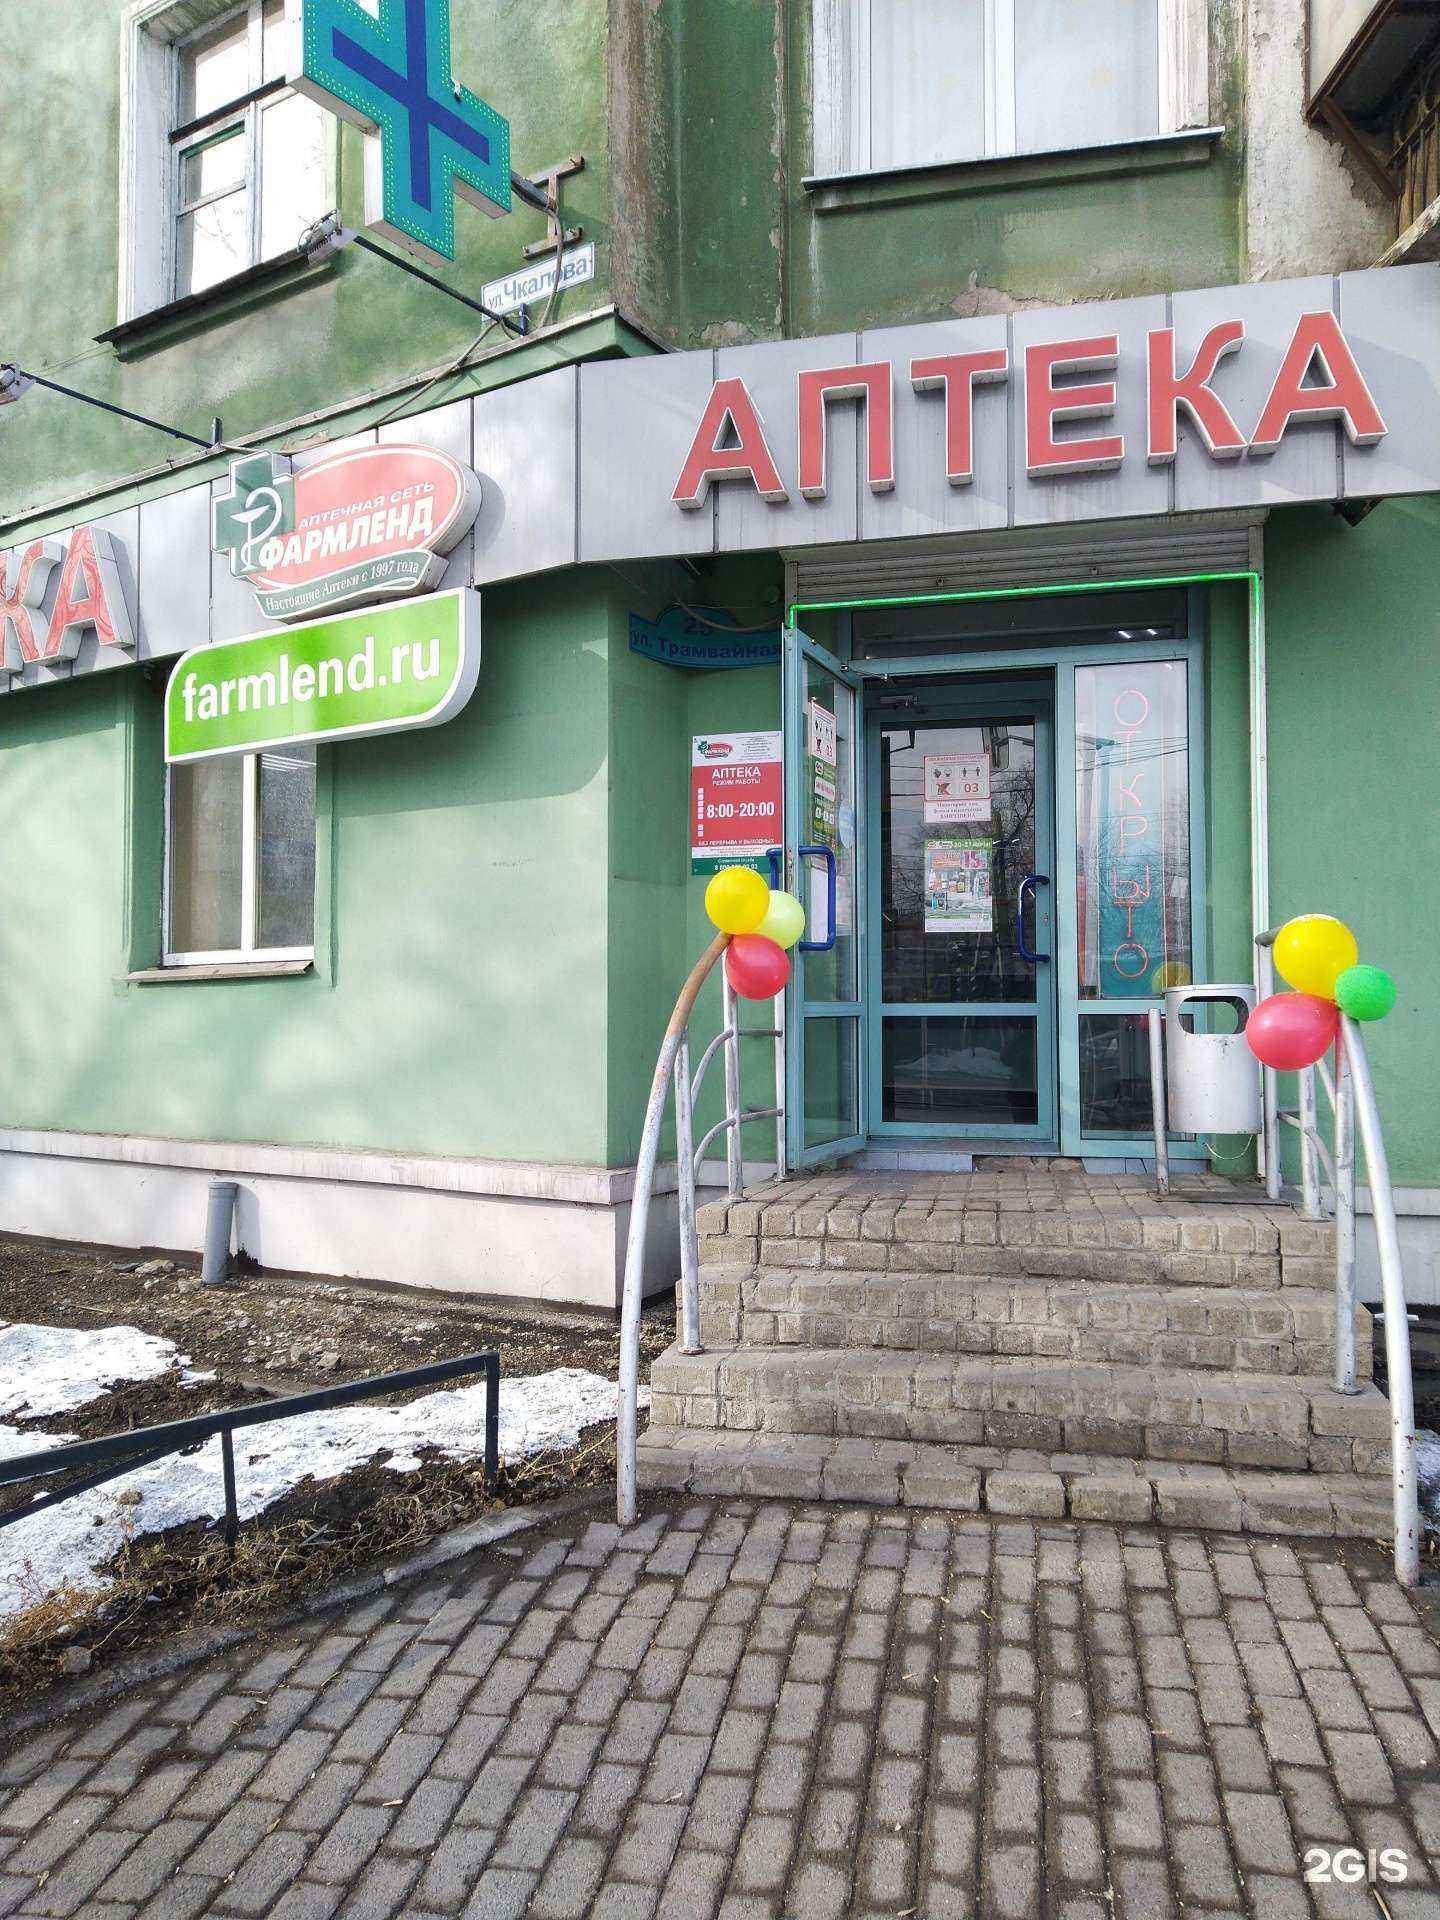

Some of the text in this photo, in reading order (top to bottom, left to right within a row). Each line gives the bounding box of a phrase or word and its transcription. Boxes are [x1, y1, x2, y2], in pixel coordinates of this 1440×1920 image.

[488, 293, 503, 310] ул.
[671, 310, 1388, 506] АПТЕКА
[298, 481, 436, 530] АПТЕЧНАЯ СЕТЬ
[257, 496, 436, 571] ФАРМЛЕНД
[264, 559, 420, 613] Настоящие Аптеки с 1997 года
[631, 631, 653, 648] ул.
[182, 632, 442, 723] farmlend.ru
[712, 766, 761, 779] АПТЕКА
[735, 778, 760, 786] РАБОТЫ
[964, 783, 980, 793] 03
[706, 802, 775, 818] 8:00-20:00
[1113, 688, 1152, 978] ОТКРЫТО
